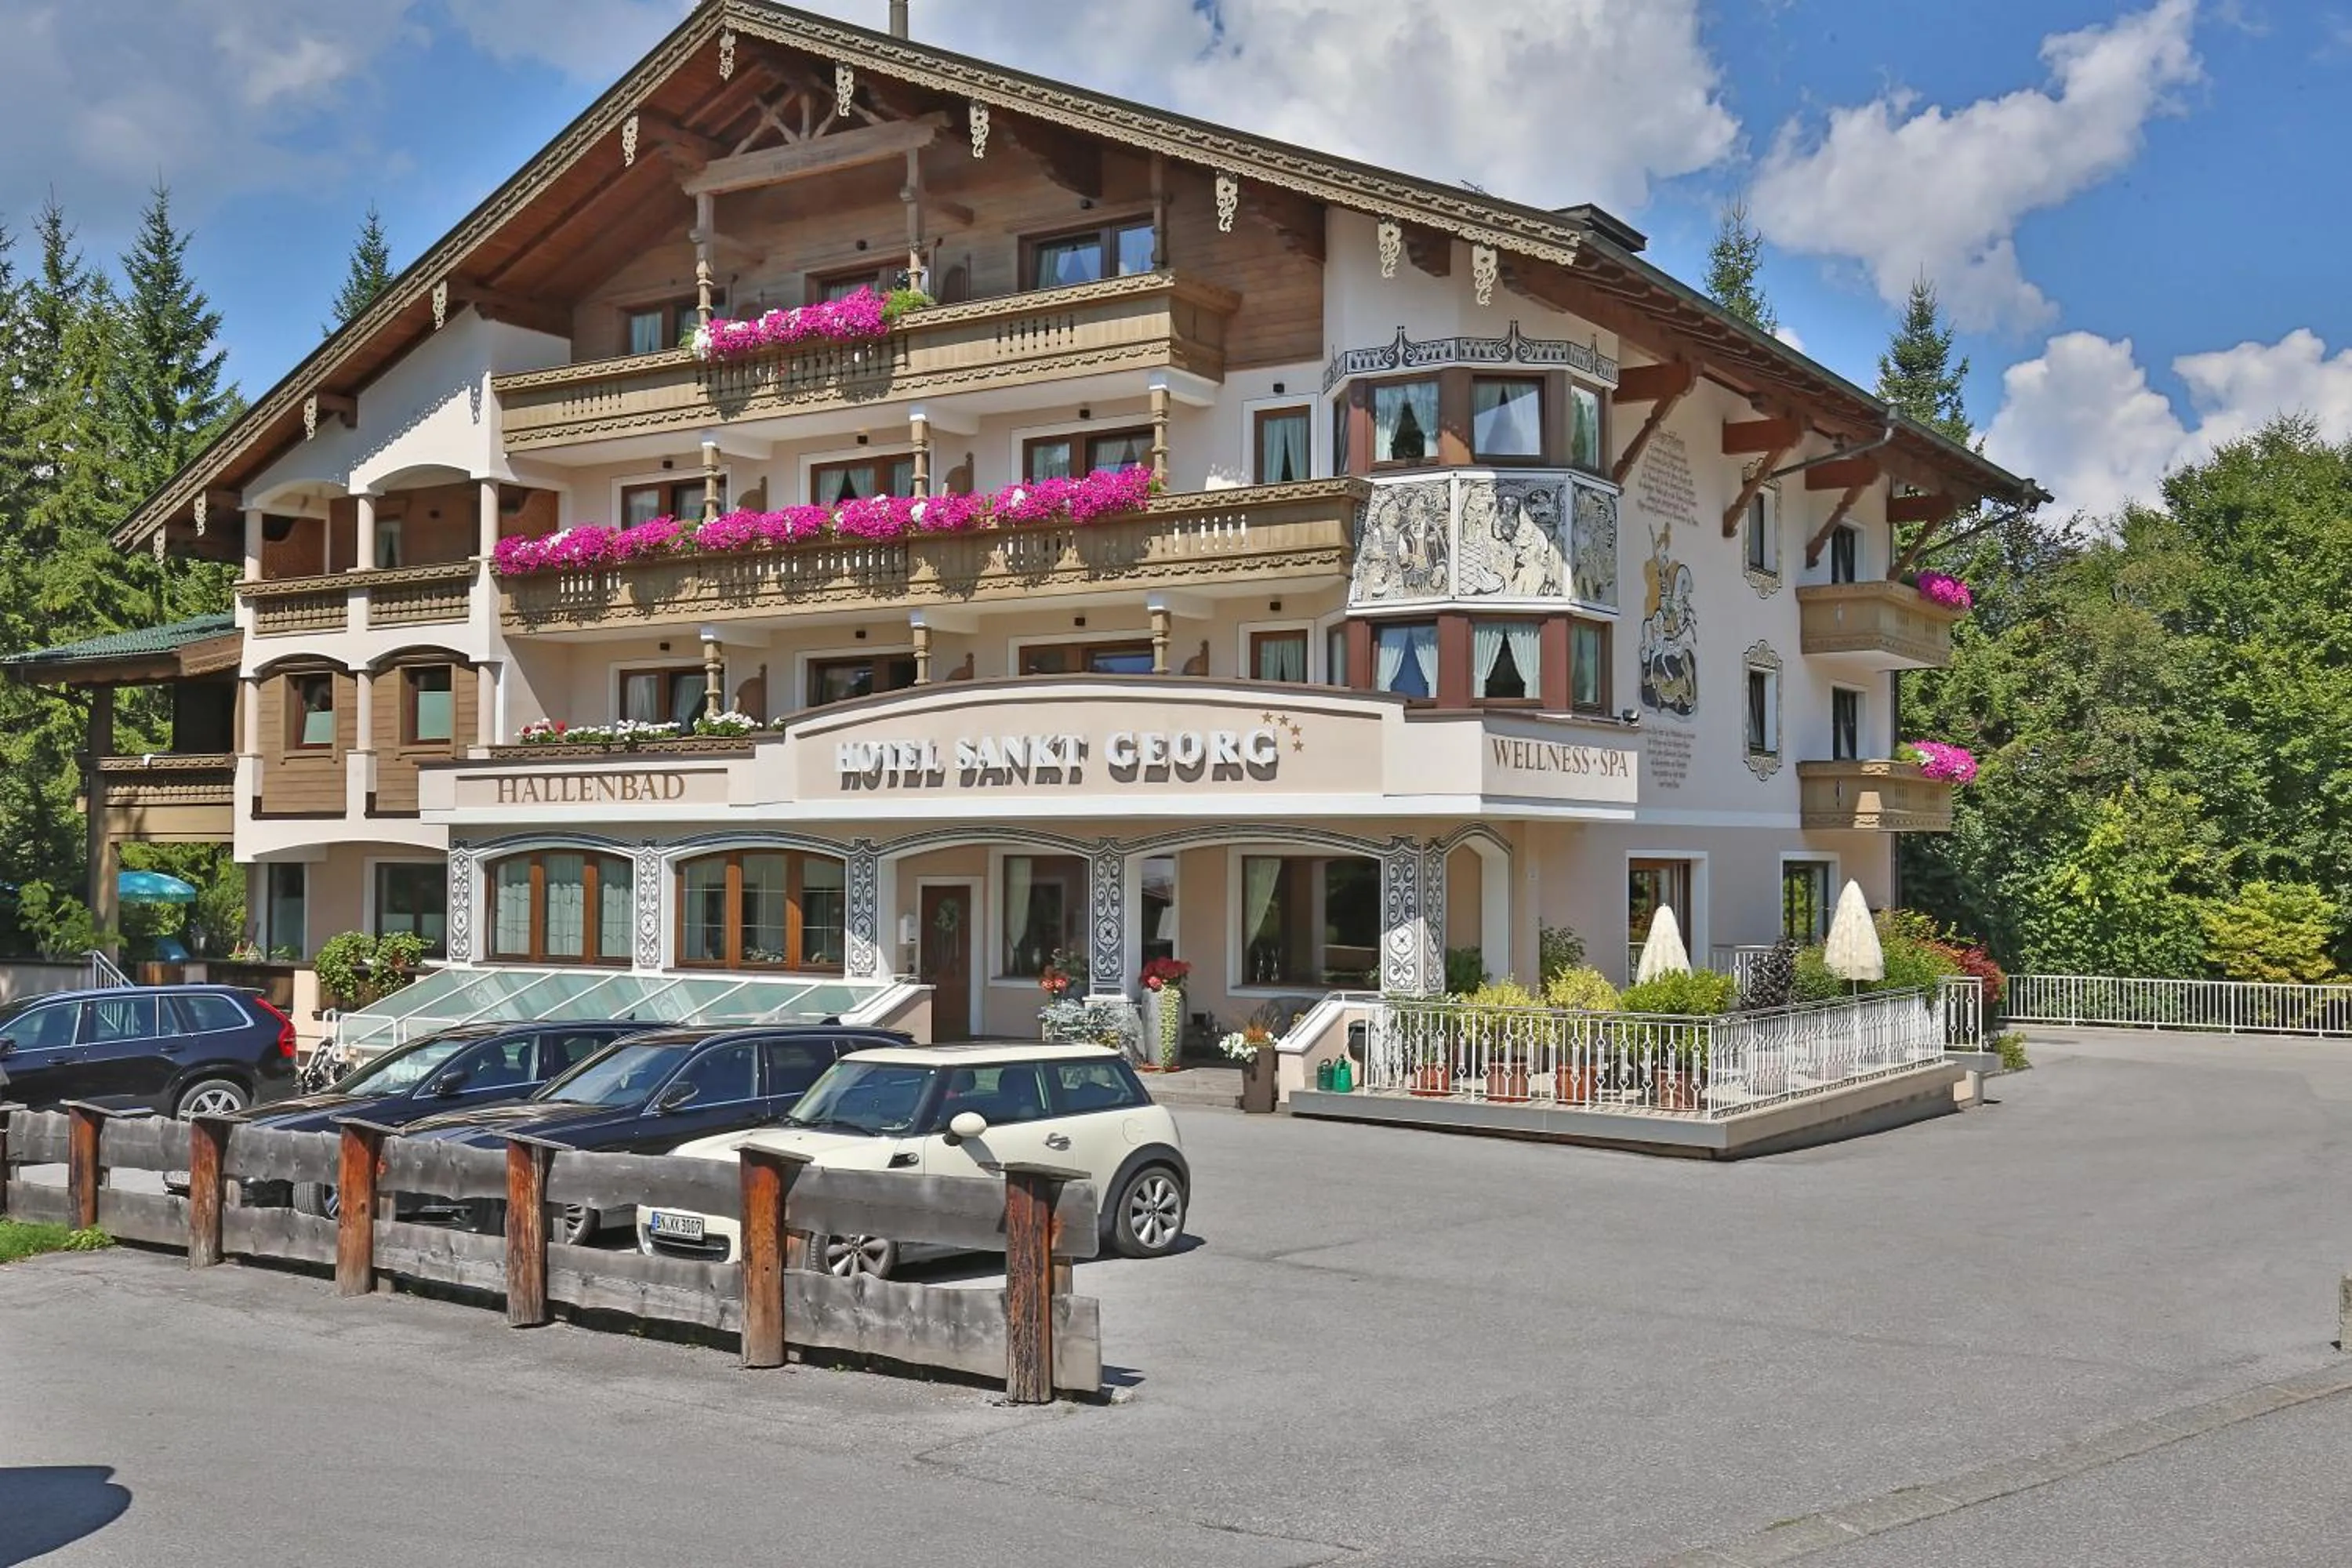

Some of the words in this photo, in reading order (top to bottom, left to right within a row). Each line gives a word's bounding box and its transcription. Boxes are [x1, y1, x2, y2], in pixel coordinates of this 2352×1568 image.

[835, 739, 943, 772] HOTEL
[955, 734, 1087, 770] SANKT
[1104, 728, 1278, 769] GEORG
[1492, 739, 1589, 775] WELLNESS
[1600, 750, 1628, 777] SPA
[497, 773, 685, 804] HALLENBAD
